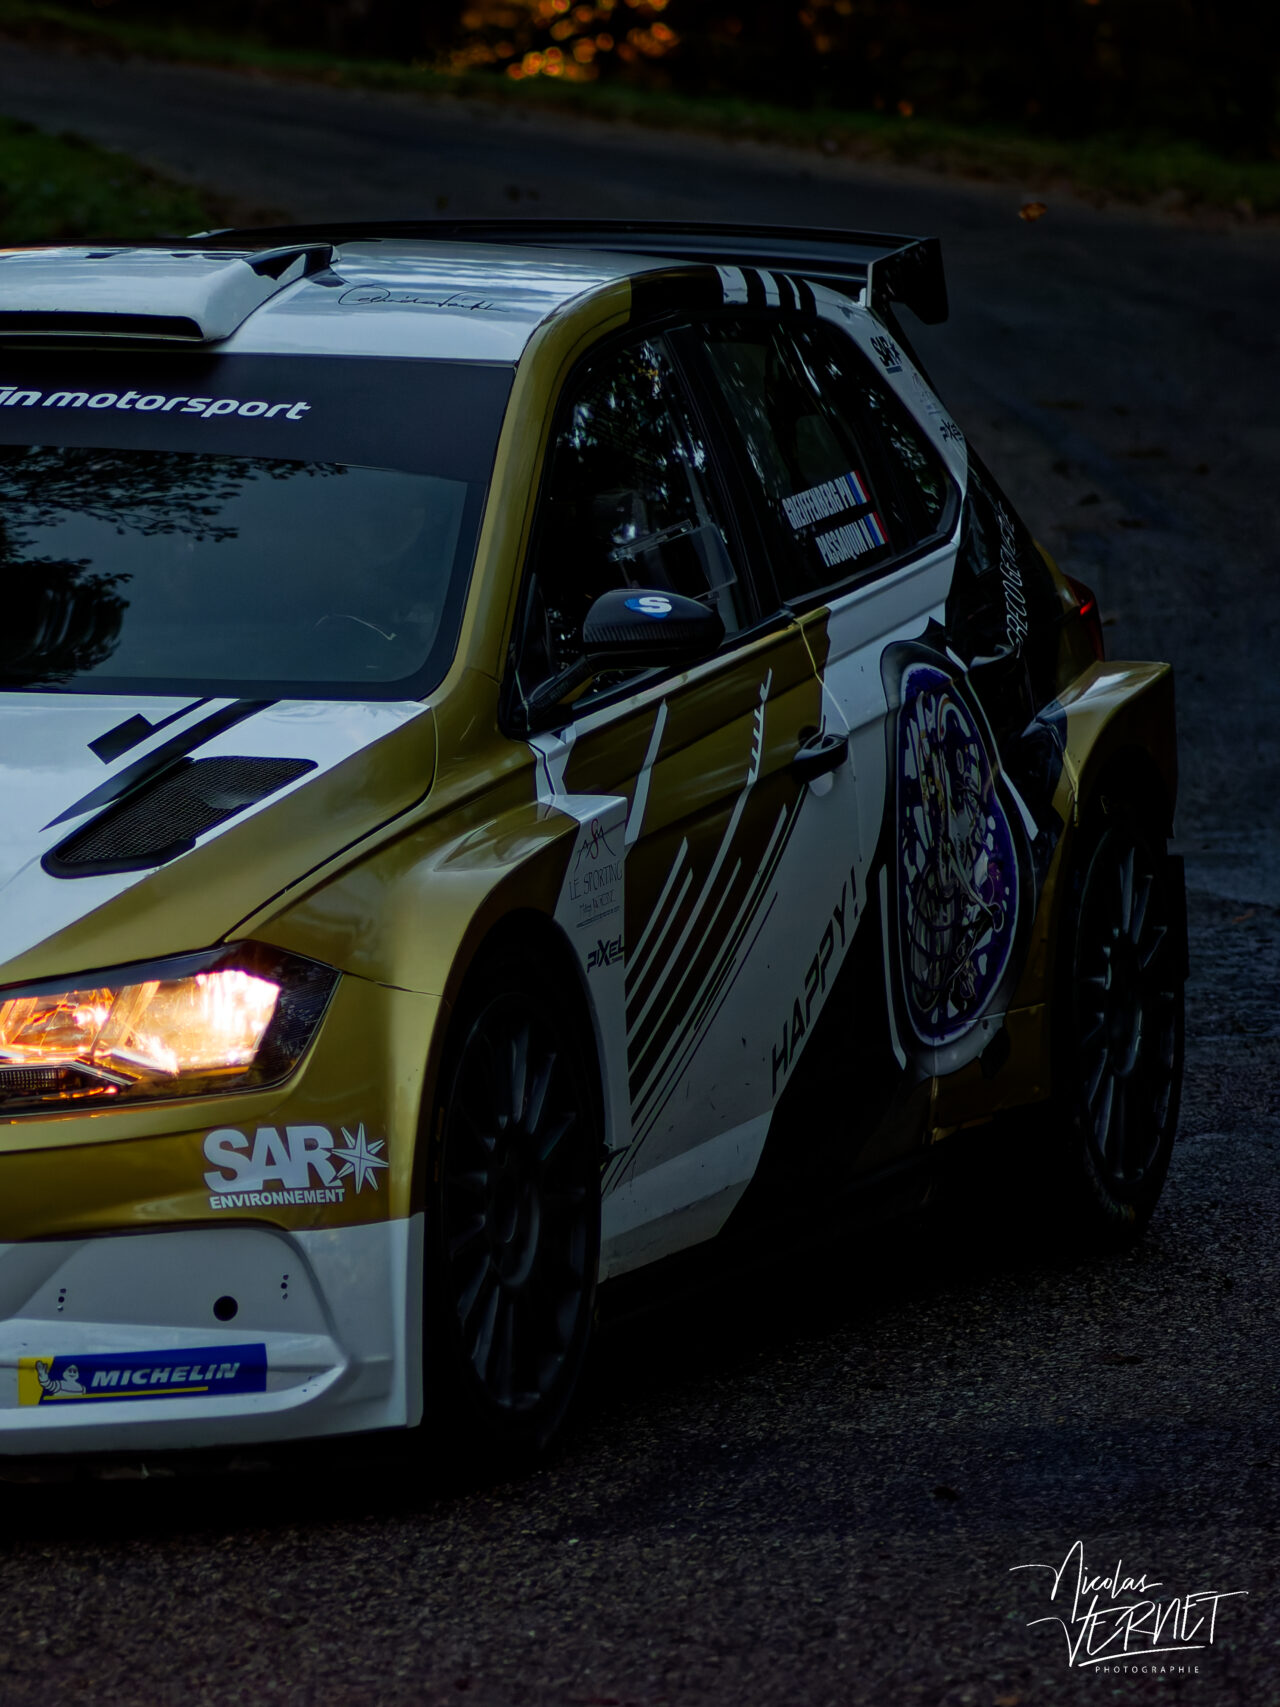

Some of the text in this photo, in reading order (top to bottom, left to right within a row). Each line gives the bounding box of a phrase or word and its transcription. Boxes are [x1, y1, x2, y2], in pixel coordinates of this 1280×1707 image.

[43, 387, 312, 419] motorsport
[583, 860, 623, 894] SPORTING
[772, 866, 858, 1098] HAPPY!
[204, 1126, 343, 1193] SAR
[209, 1188, 345, 1210] ENVIRONNEMENT
[90, 1362, 241, 1388] MICHELIN
